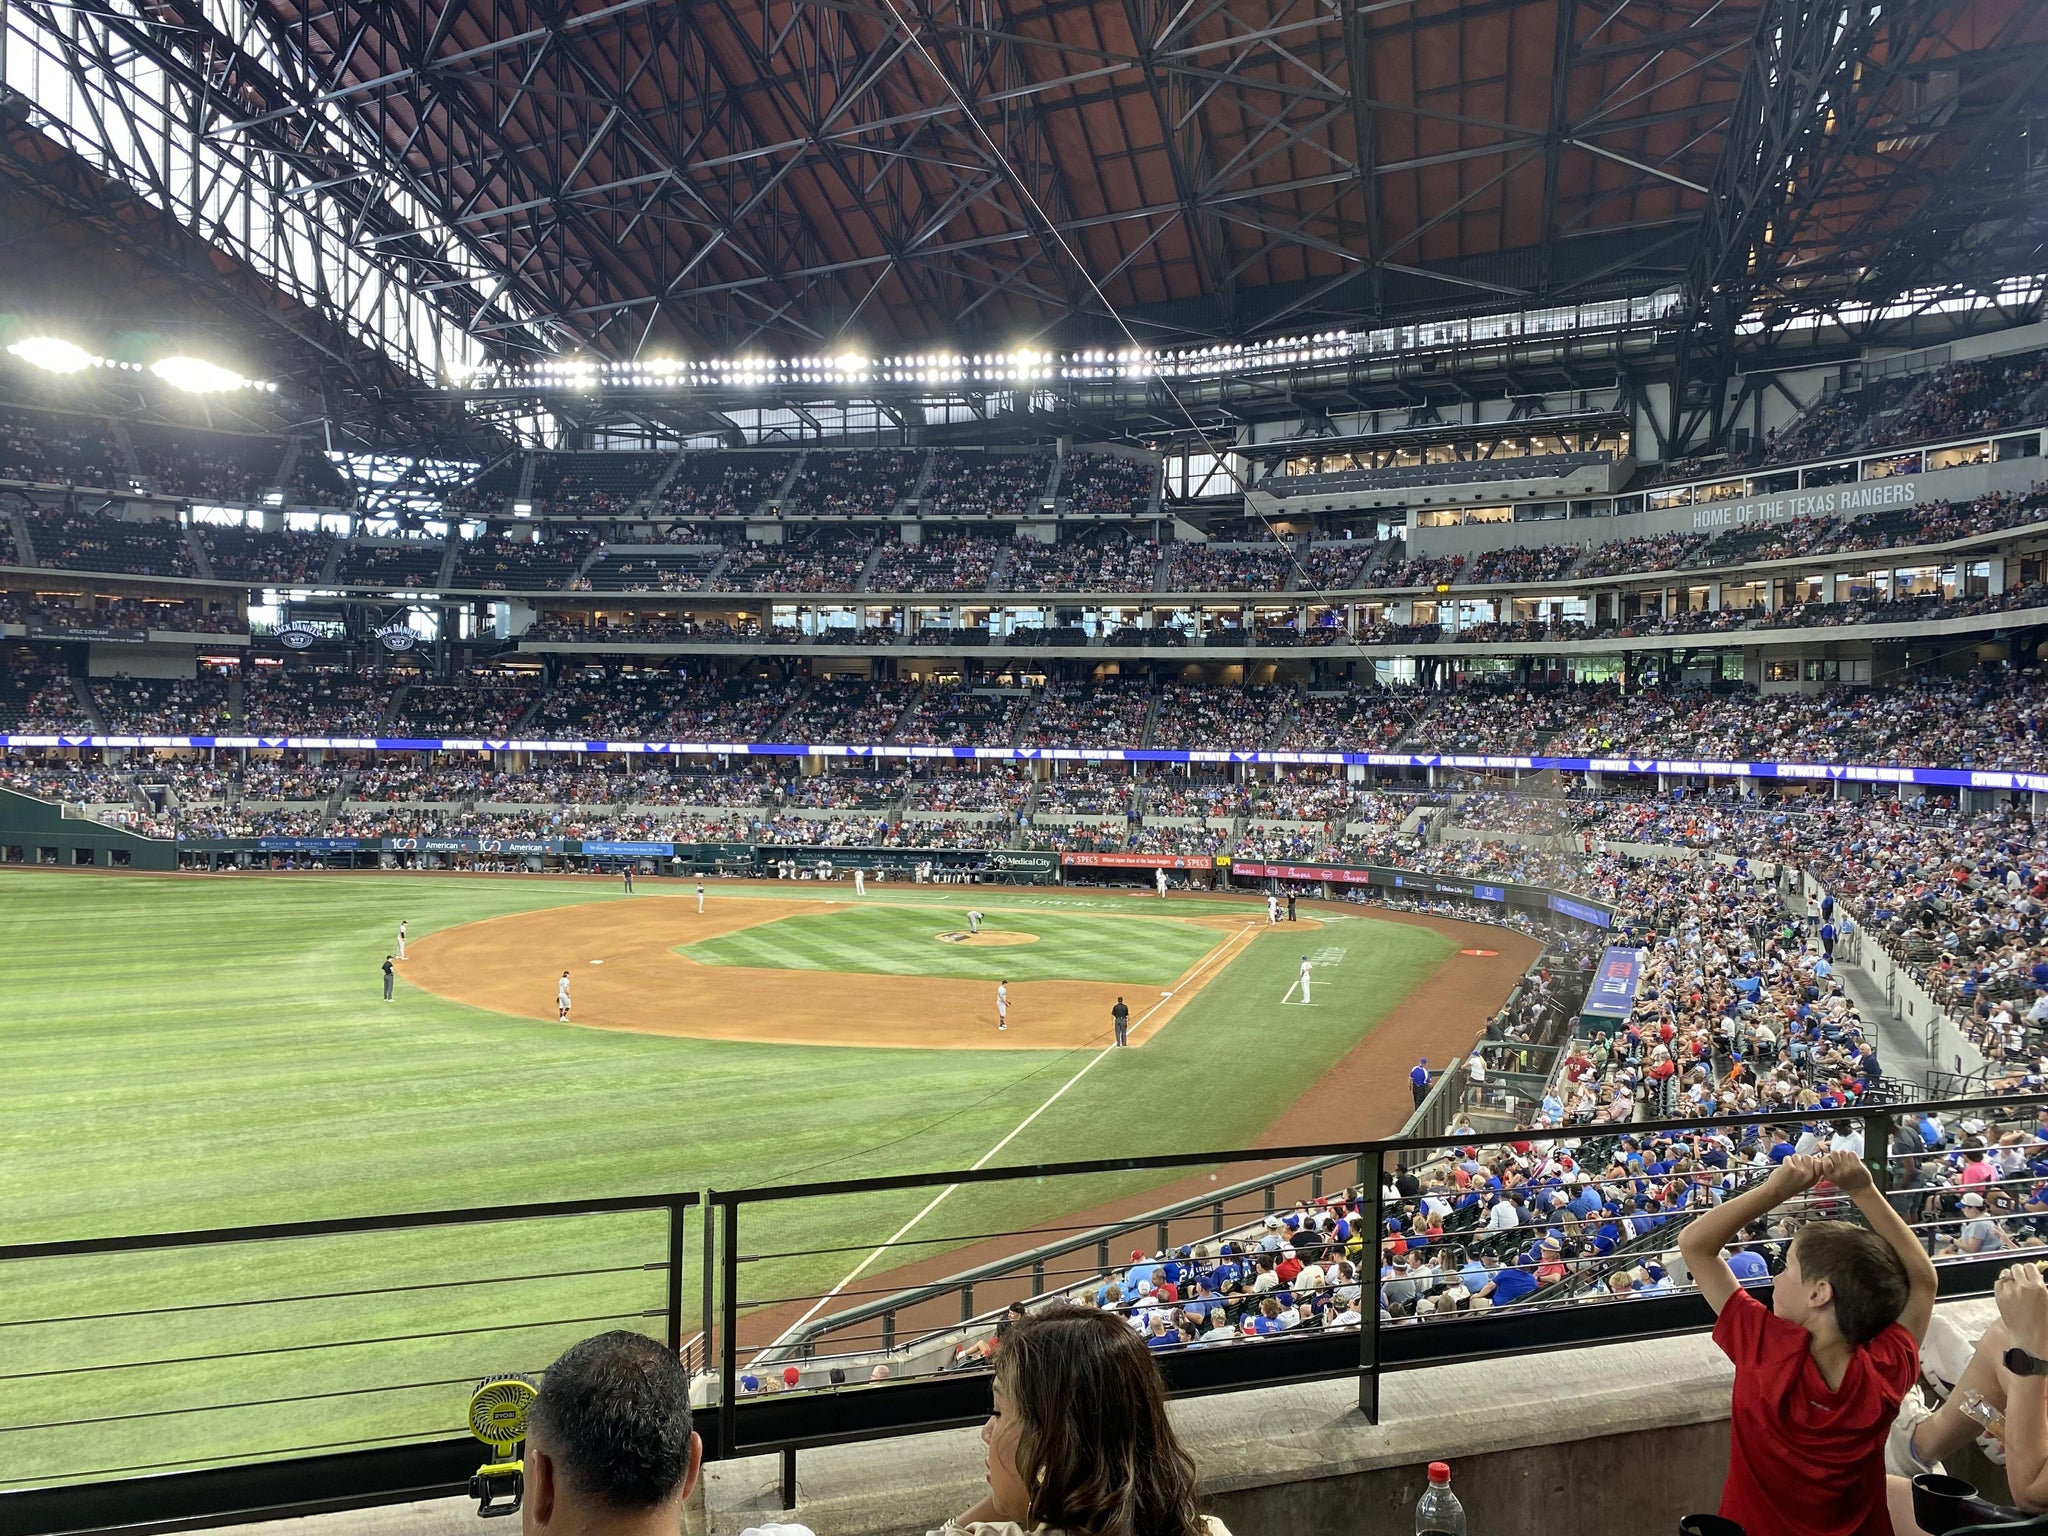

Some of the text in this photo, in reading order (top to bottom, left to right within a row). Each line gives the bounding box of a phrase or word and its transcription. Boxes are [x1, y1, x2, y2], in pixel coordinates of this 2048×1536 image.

[1693, 482, 1915, 528] HOME OF THE TEXAS RANGERS
[273, 623, 292, 636] JACK
[374, 625, 393, 639] JACK
[391, 838, 458, 850] 100 American
[478, 839, 543, 852] 100 American
[1008, 857, 1051, 868] Medical City
[1076, 855, 1099, 864] SPEC'S
[1187, 857, 1210, 867] SPEC'S
[1441, 885, 1455, 893] Globe
